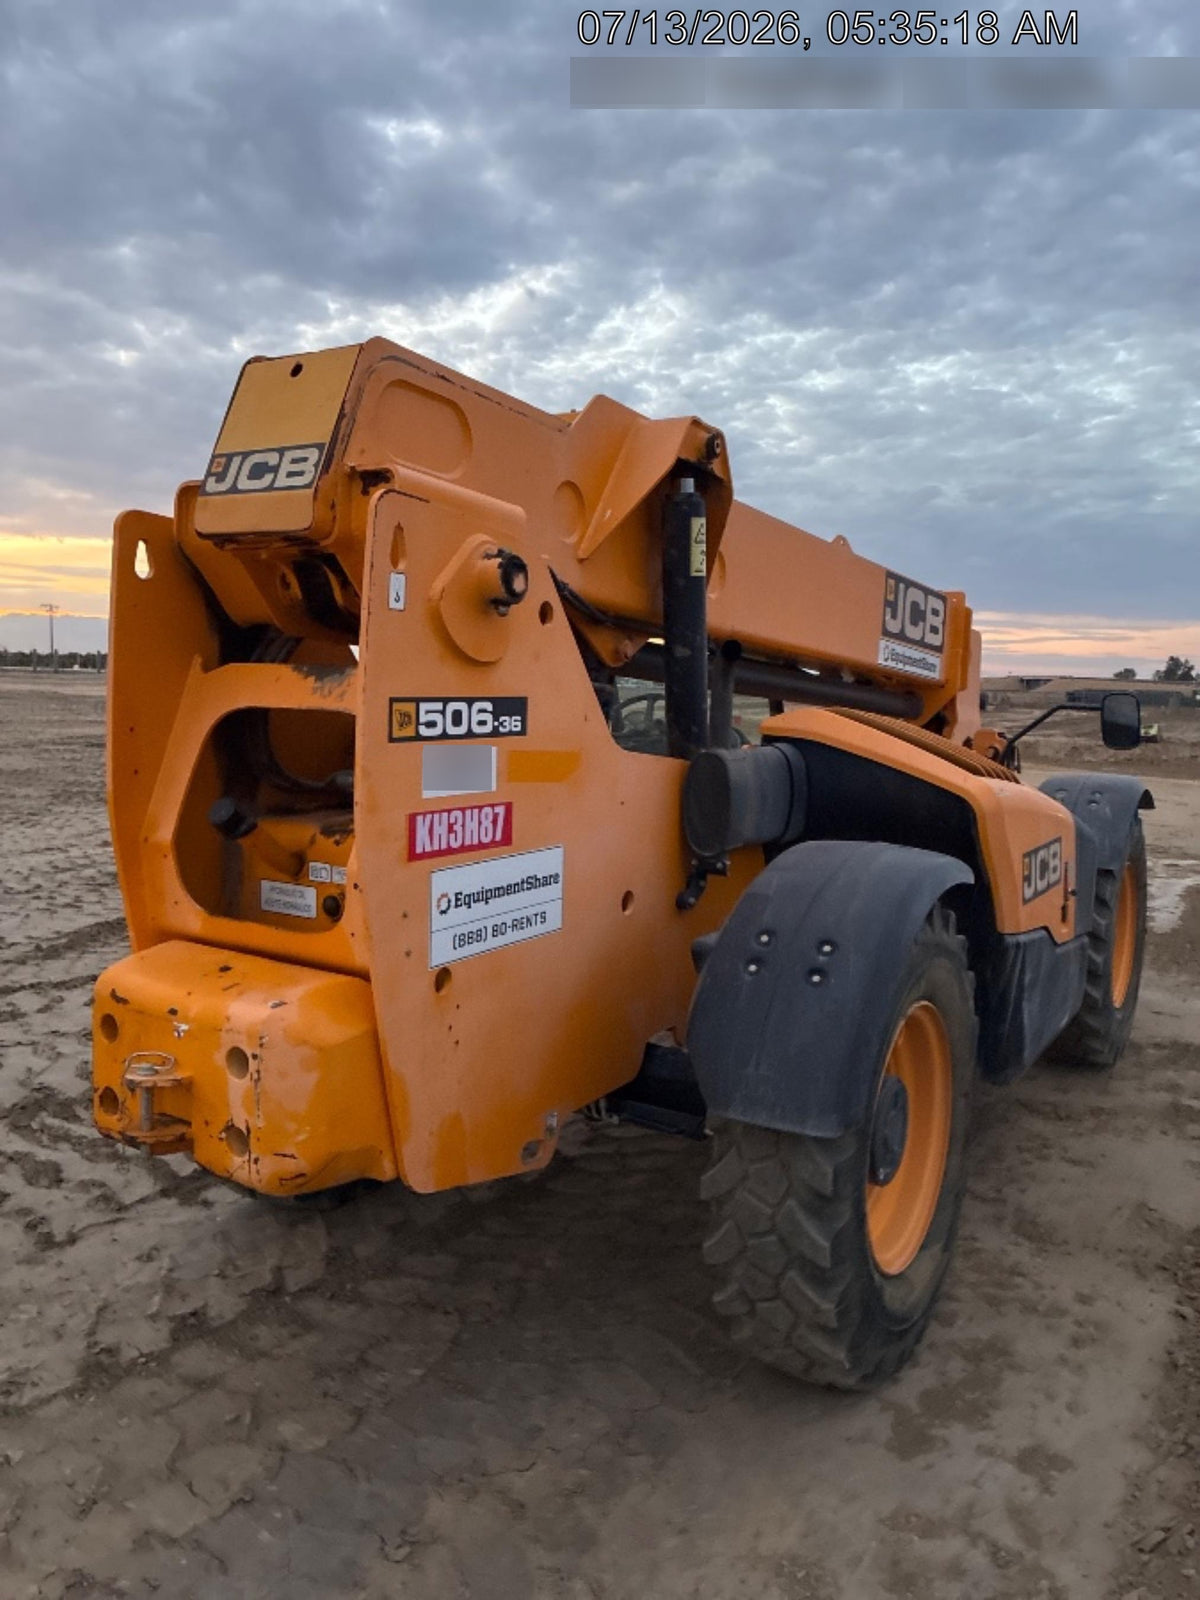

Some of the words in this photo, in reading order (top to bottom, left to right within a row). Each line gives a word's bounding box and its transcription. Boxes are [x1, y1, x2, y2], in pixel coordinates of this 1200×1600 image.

[205, 447, 320, 493] JCB
[885, 582, 945, 647] JCB
[414, 804, 506, 855] KH3H87
[453, 871, 561, 910] EquipmentShare
[1023, 842, 1061, 901] JCB
